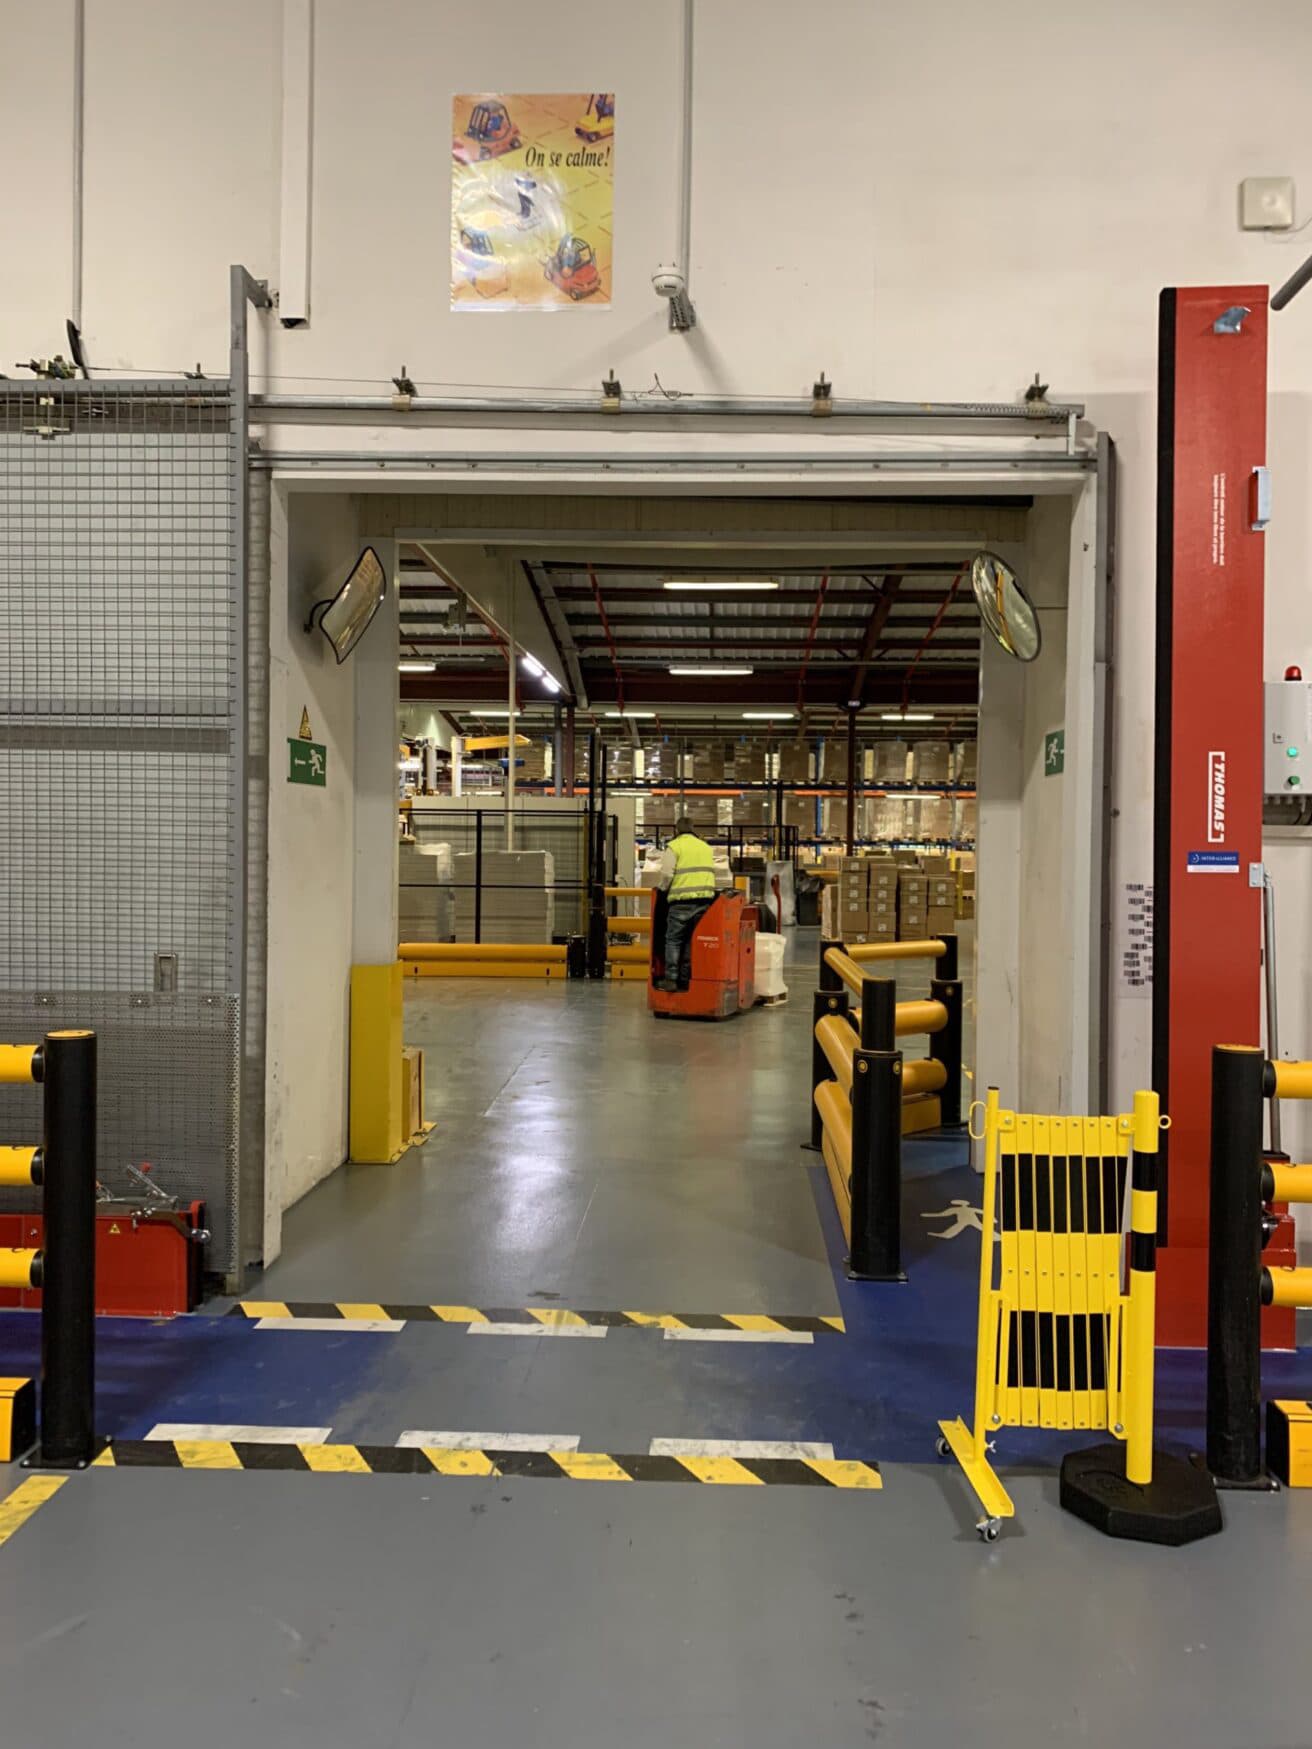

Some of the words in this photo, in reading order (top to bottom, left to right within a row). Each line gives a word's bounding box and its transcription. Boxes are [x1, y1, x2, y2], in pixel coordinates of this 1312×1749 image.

[526, 146, 545, 167] On
[549, 152, 562, 167] se
[566, 146, 611, 167] calme!
[1214, 762, 1225, 832] THOMAS
